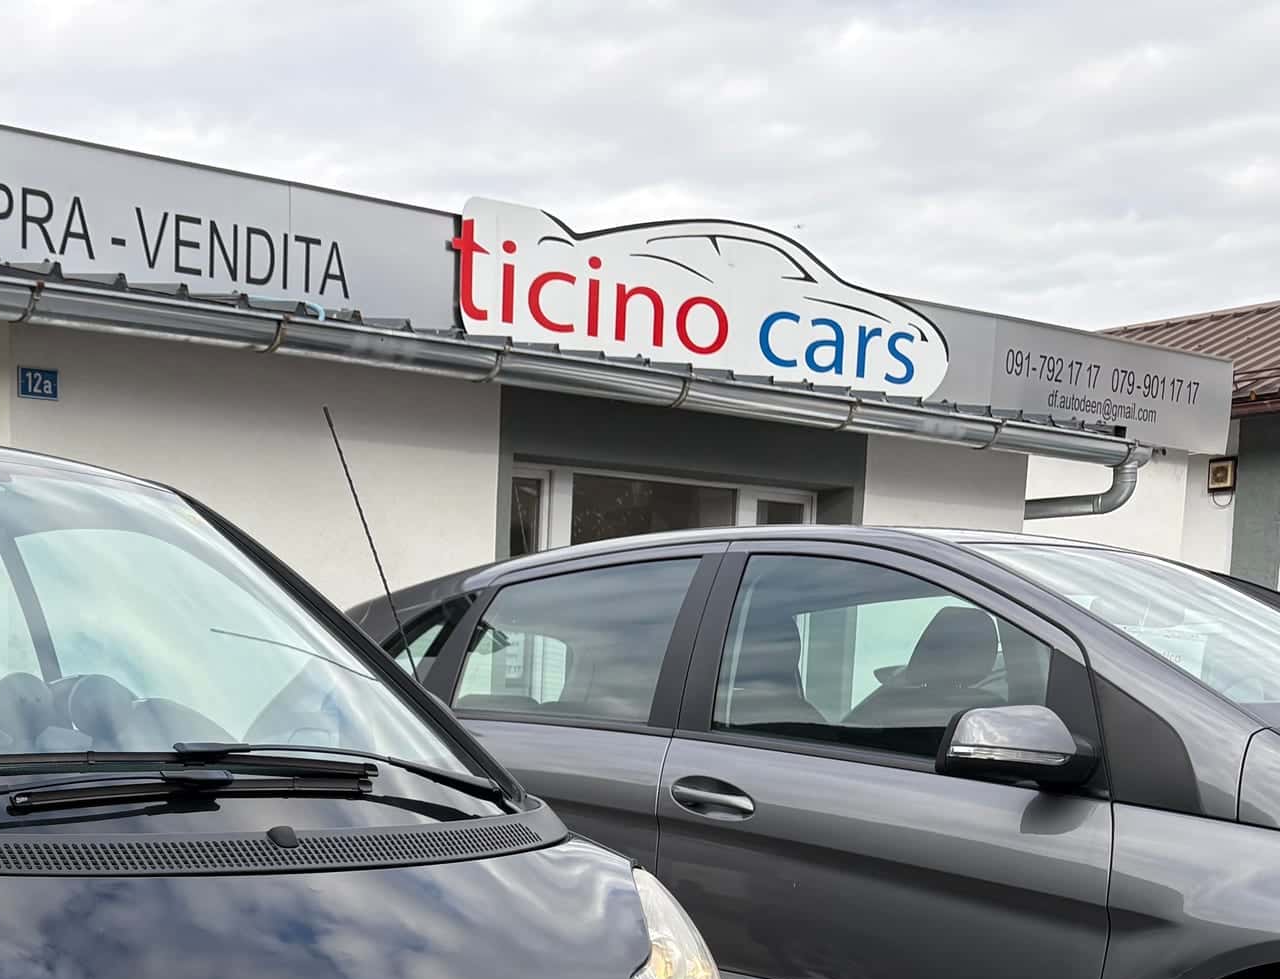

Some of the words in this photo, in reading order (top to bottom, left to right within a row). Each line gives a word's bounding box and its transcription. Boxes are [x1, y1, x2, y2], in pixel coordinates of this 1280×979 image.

[451, 218, 730, 357] ticino
[758, 310, 916, 386] cars
[25, 371, 53, 394] 12a
[1005, 348, 1064, 383] 091-792
[1067, 359, 1083, 387] 17
[1086, 363, 1101, 390] 17
[1111, 367, 1166, 401] 079-901
[1170, 377, 1184, 403] 17
[1186, 380, 1200, 406] 17
[1047, 389, 1158, 424] df.autodeen@gmail.com
